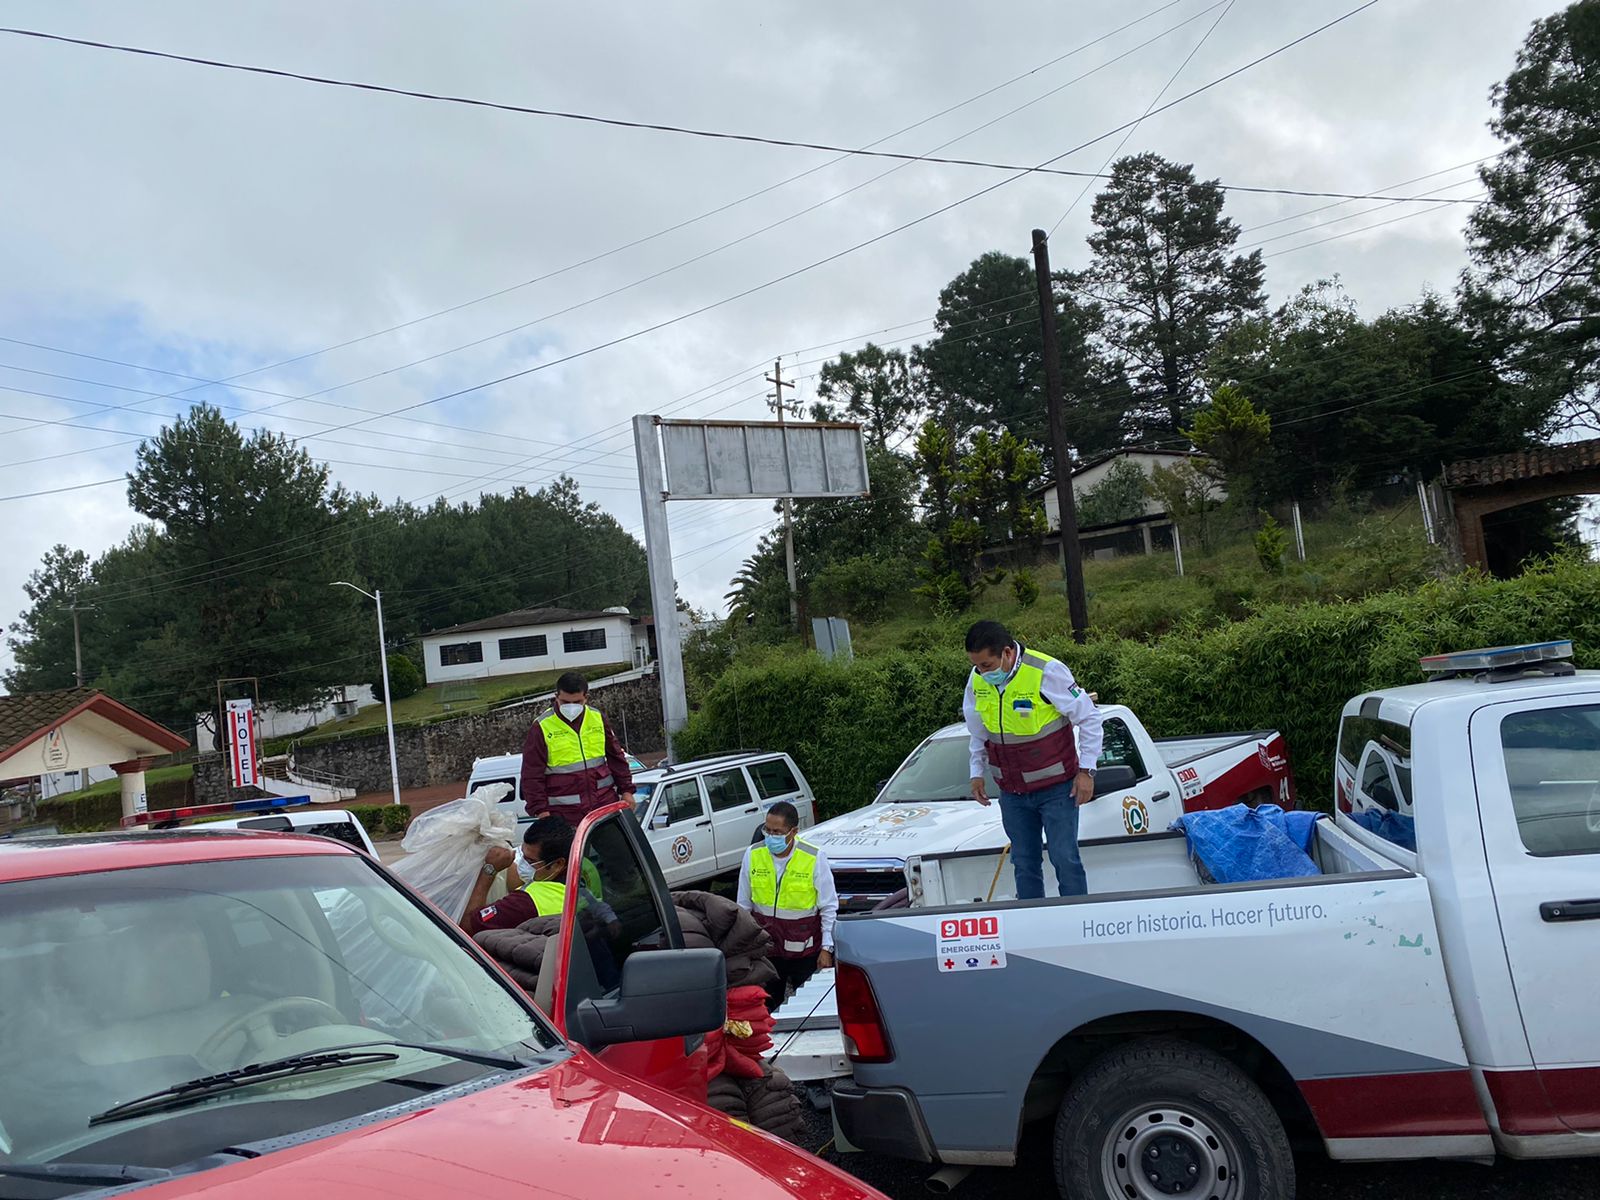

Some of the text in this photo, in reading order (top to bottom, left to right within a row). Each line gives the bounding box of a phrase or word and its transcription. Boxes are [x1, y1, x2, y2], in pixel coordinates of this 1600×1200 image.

[237, 713, 250, 785] HOTEL
[1178, 768, 1197, 782] 911
[943, 918, 995, 937] 911
[1083, 902, 1328, 938] Hacer historia. Hacer futuro.
[941, 943, 1002, 954] EMERGENCIAS
